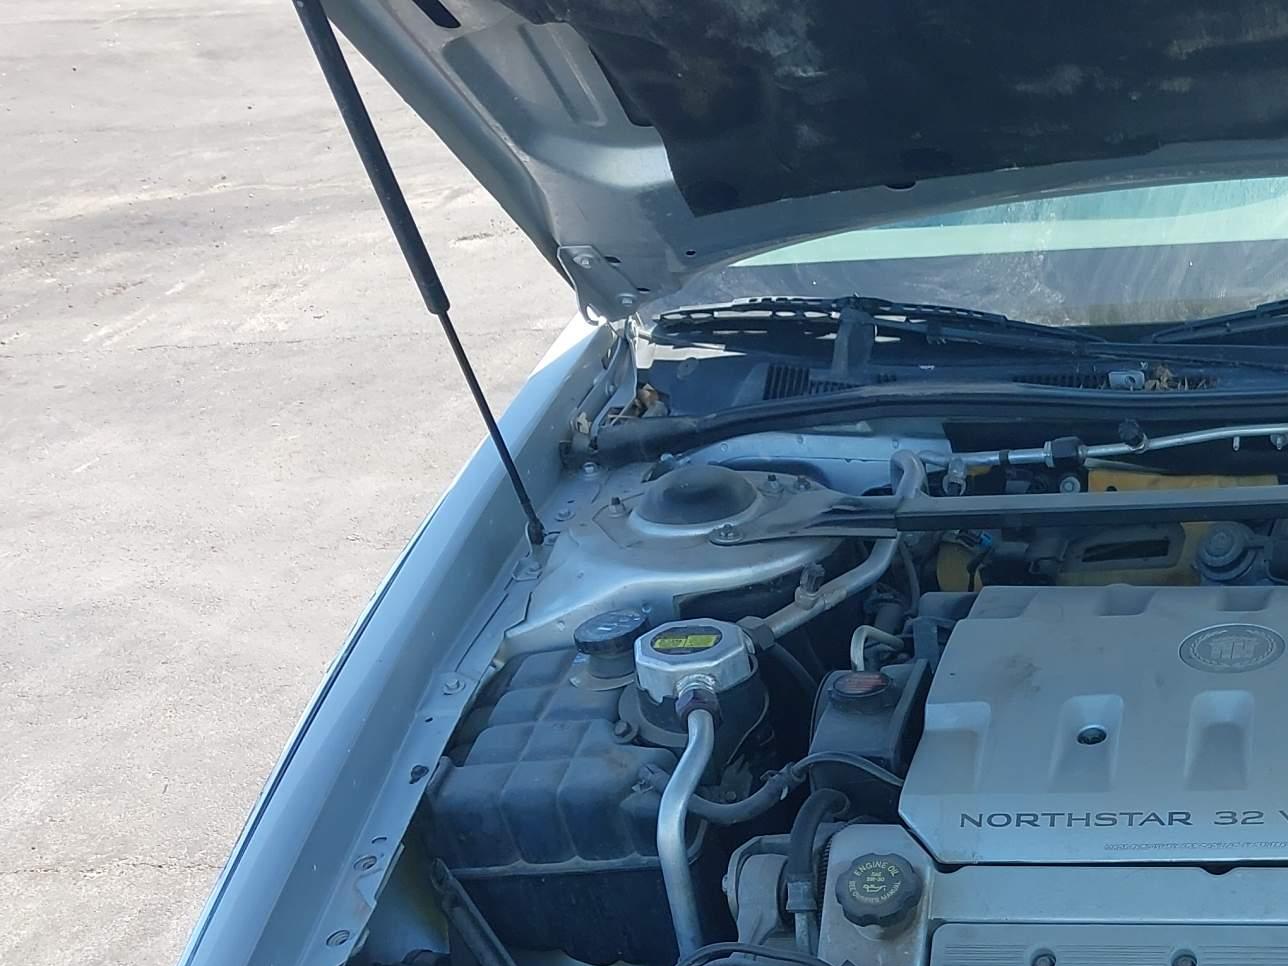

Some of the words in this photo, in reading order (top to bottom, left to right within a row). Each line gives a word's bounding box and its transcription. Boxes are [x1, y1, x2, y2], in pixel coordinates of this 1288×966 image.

[960, 811, 1193, 828] NORTHSTAR
[1213, 810, 1265, 826] 32
[854, 861, 889, 876] ENGINE
[887, 865, 900, 877] OIL
